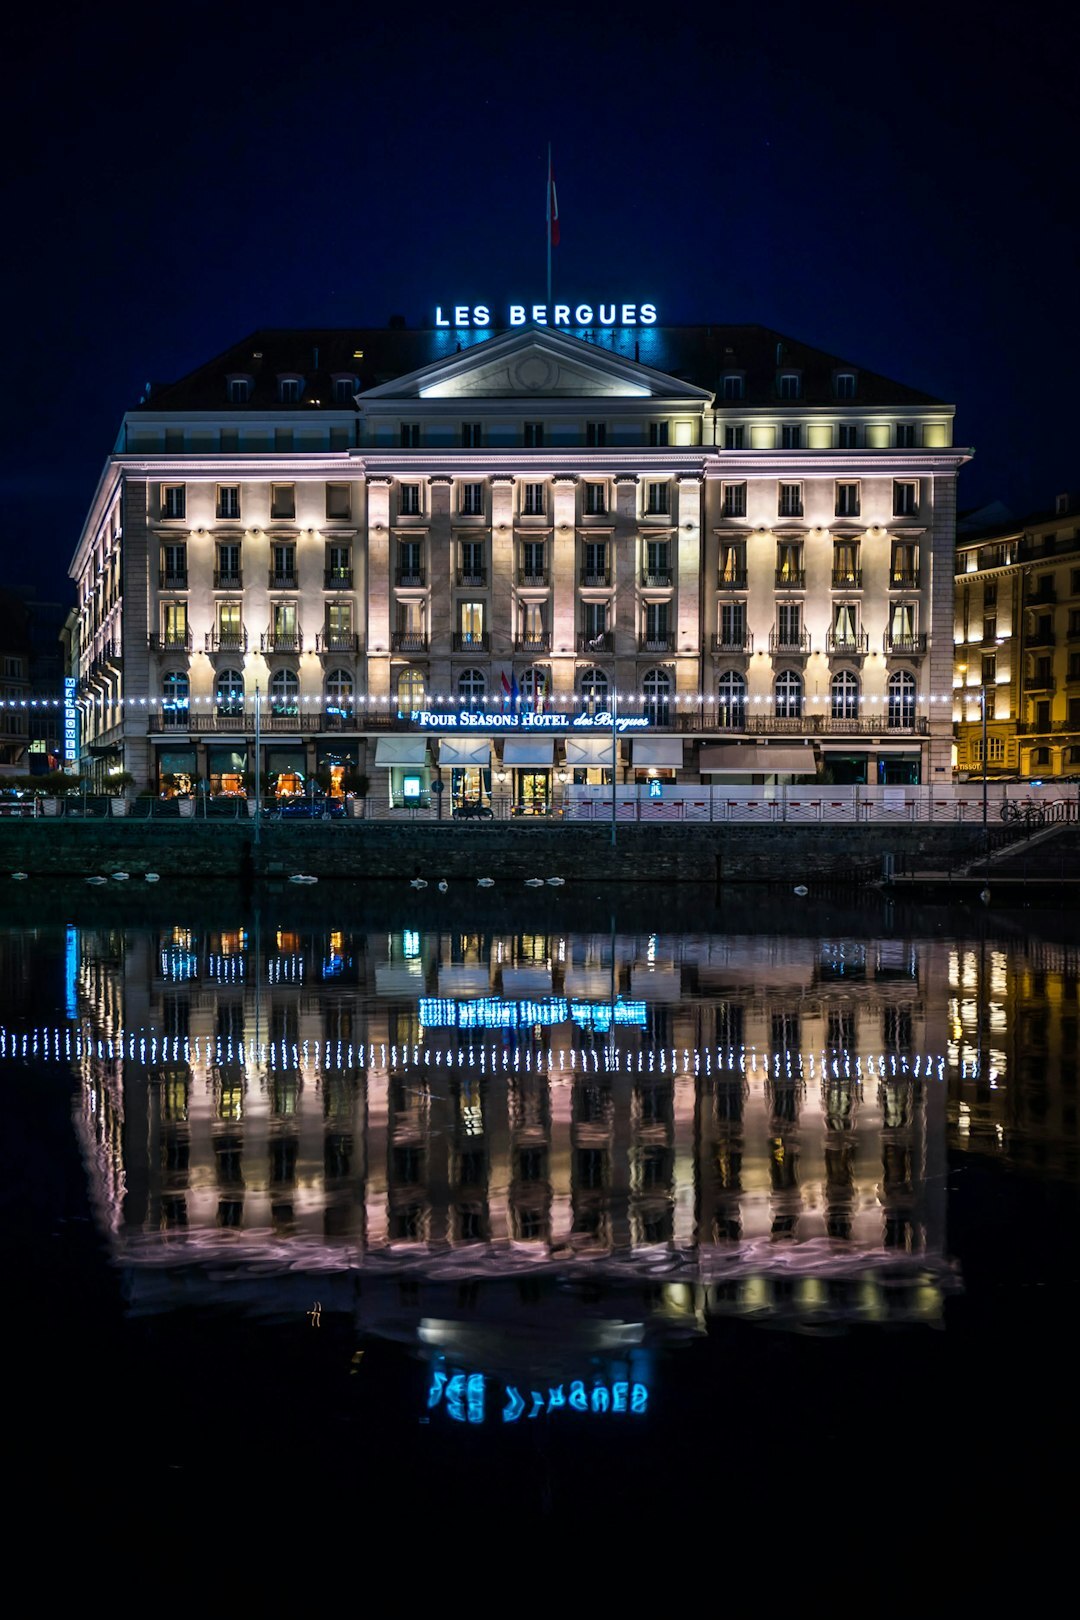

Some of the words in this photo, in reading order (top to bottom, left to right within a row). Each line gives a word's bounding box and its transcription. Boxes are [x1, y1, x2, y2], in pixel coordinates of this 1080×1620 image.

[435, 305, 490, 326] LES
[510, 304, 657, 325] BERGUES
[65, 678, 75, 759] MANPOWER
[419, 711, 457, 726] FOUR
[460, 711, 518, 726] SEASONS
[521, 711, 569, 726] HOTEL
[573, 712, 593, 726] des
[959, 763, 981, 771] TISSOT
